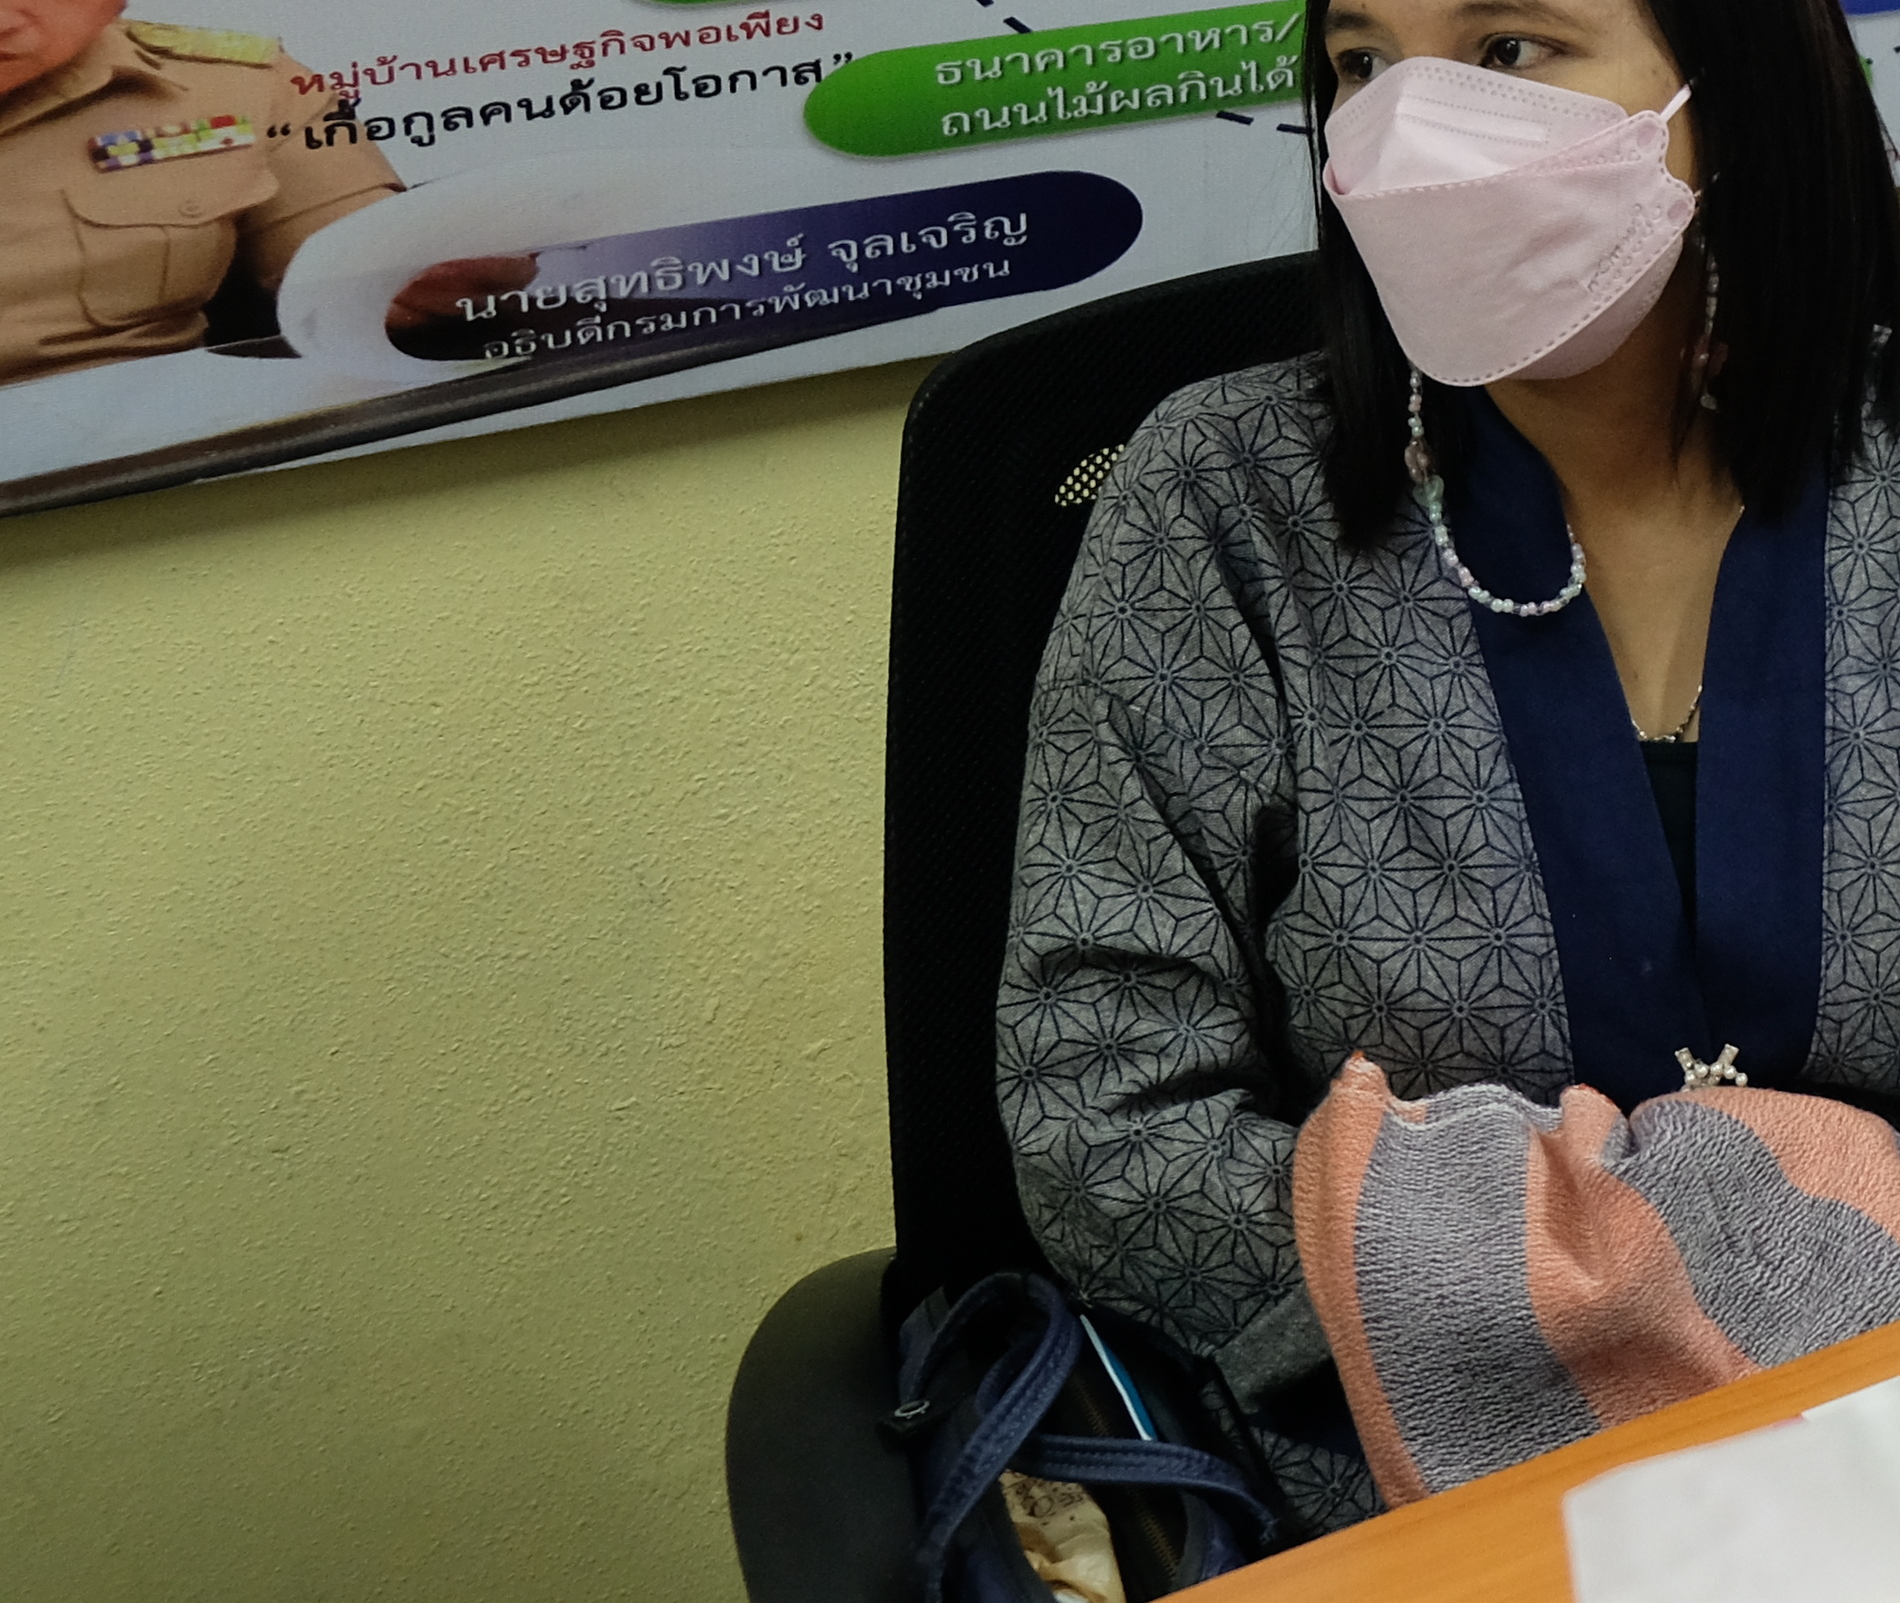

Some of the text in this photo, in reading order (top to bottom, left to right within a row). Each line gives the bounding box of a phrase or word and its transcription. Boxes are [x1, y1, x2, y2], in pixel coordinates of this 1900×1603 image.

[290, 10, 825, 102] หมู่บ้านเศรษฐกิจพอเพียง
[934, 12, 1301, 88] ธนาคารอาหาร/
[940, 53, 1297, 140] ถนนไม้ผลกินได้
[456, 208, 1030, 323] นายสุทธิพงษ์ จุลเจริญ
[482, 254, 1011, 361] อธิบดีกรมการพัฒนาชุมชน
